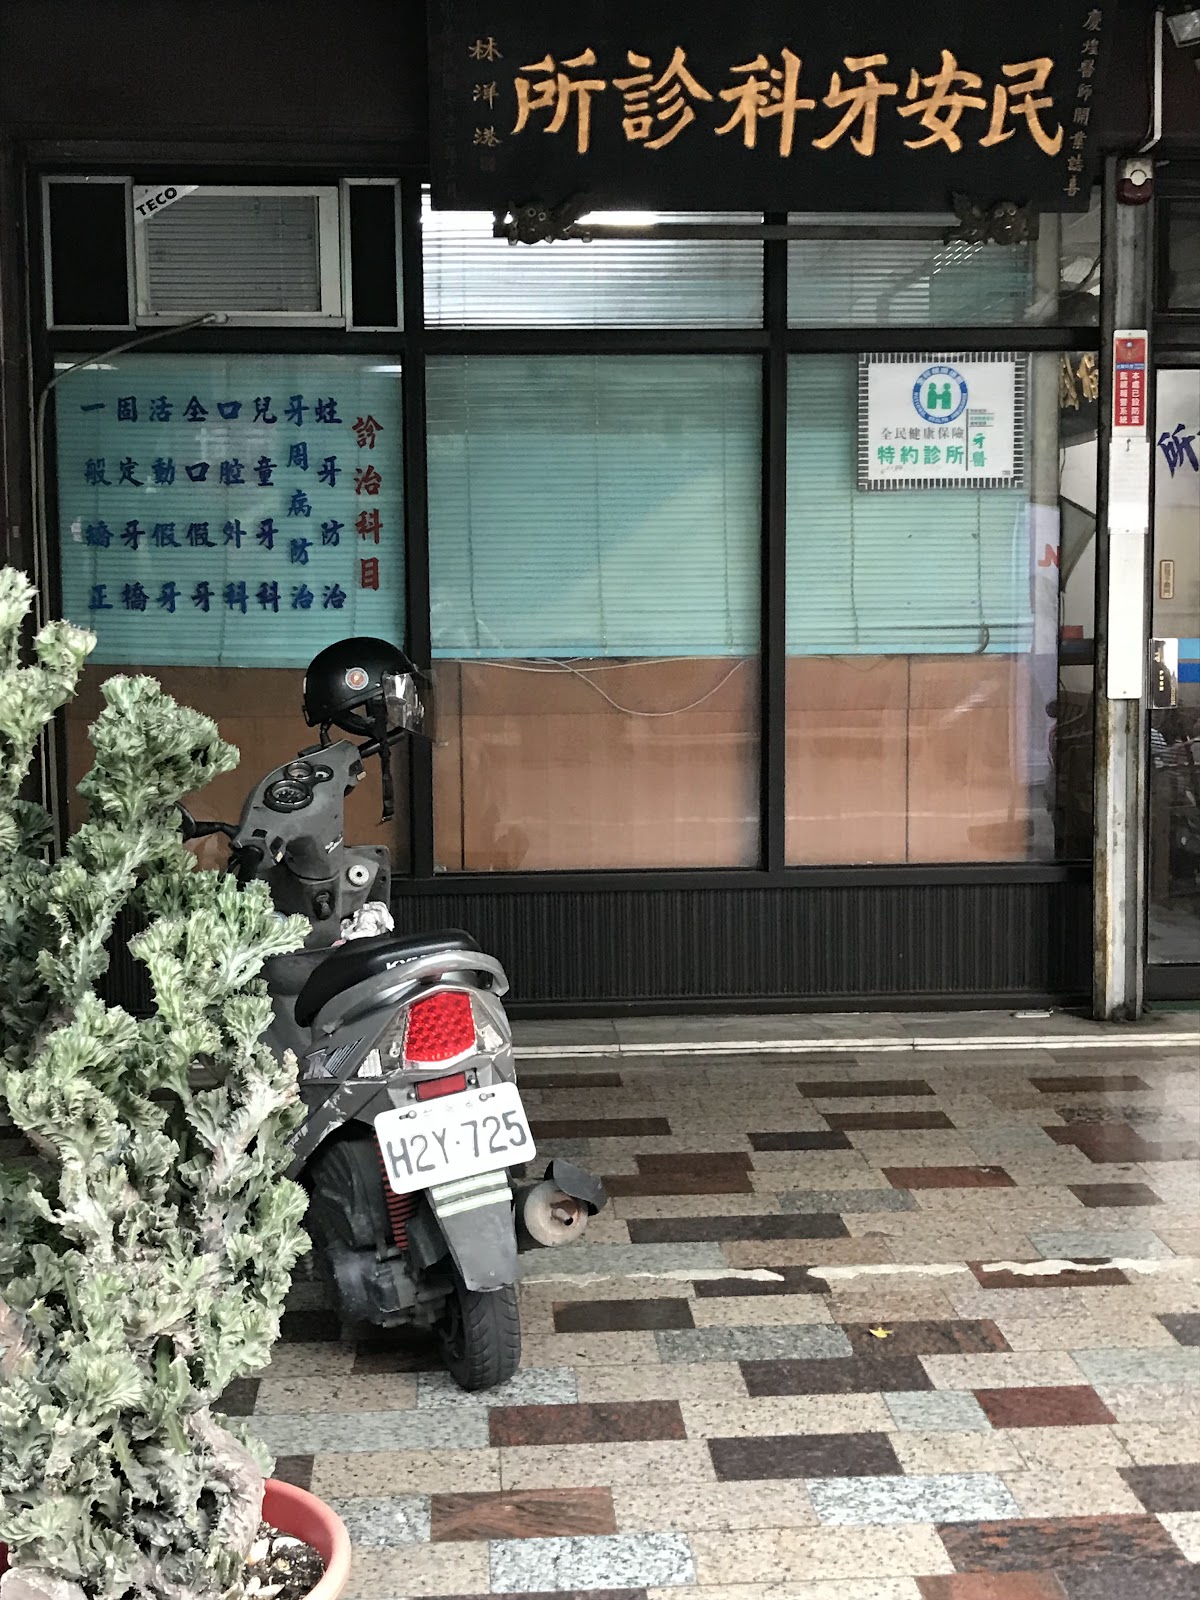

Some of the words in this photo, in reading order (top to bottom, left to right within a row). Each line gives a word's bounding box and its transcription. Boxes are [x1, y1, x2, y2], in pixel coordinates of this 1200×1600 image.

[468, 37, 503, 147] 林洋港
[511, 48, 1064, 157] 民安牙科診所
[135, 187, 177, 216] TECO
[117, 396, 150, 612] 固定牙橋
[149, 395, 182, 613] 活動假牙
[183, 395, 217, 612] 全口假牙
[217, 400, 249, 614] 口腔外科
[253, 396, 281, 613] 兒童牙科
[284, 394, 315, 609] 牙周病防治
[315, 397, 347, 609] 蛀牙防治
[352, 415, 384, 591] 診治科目
[877, 445, 964, 465] 特約診所
[881, 427, 964, 440] 全民健康保險
[972, 433, 987, 467] 牙醫
